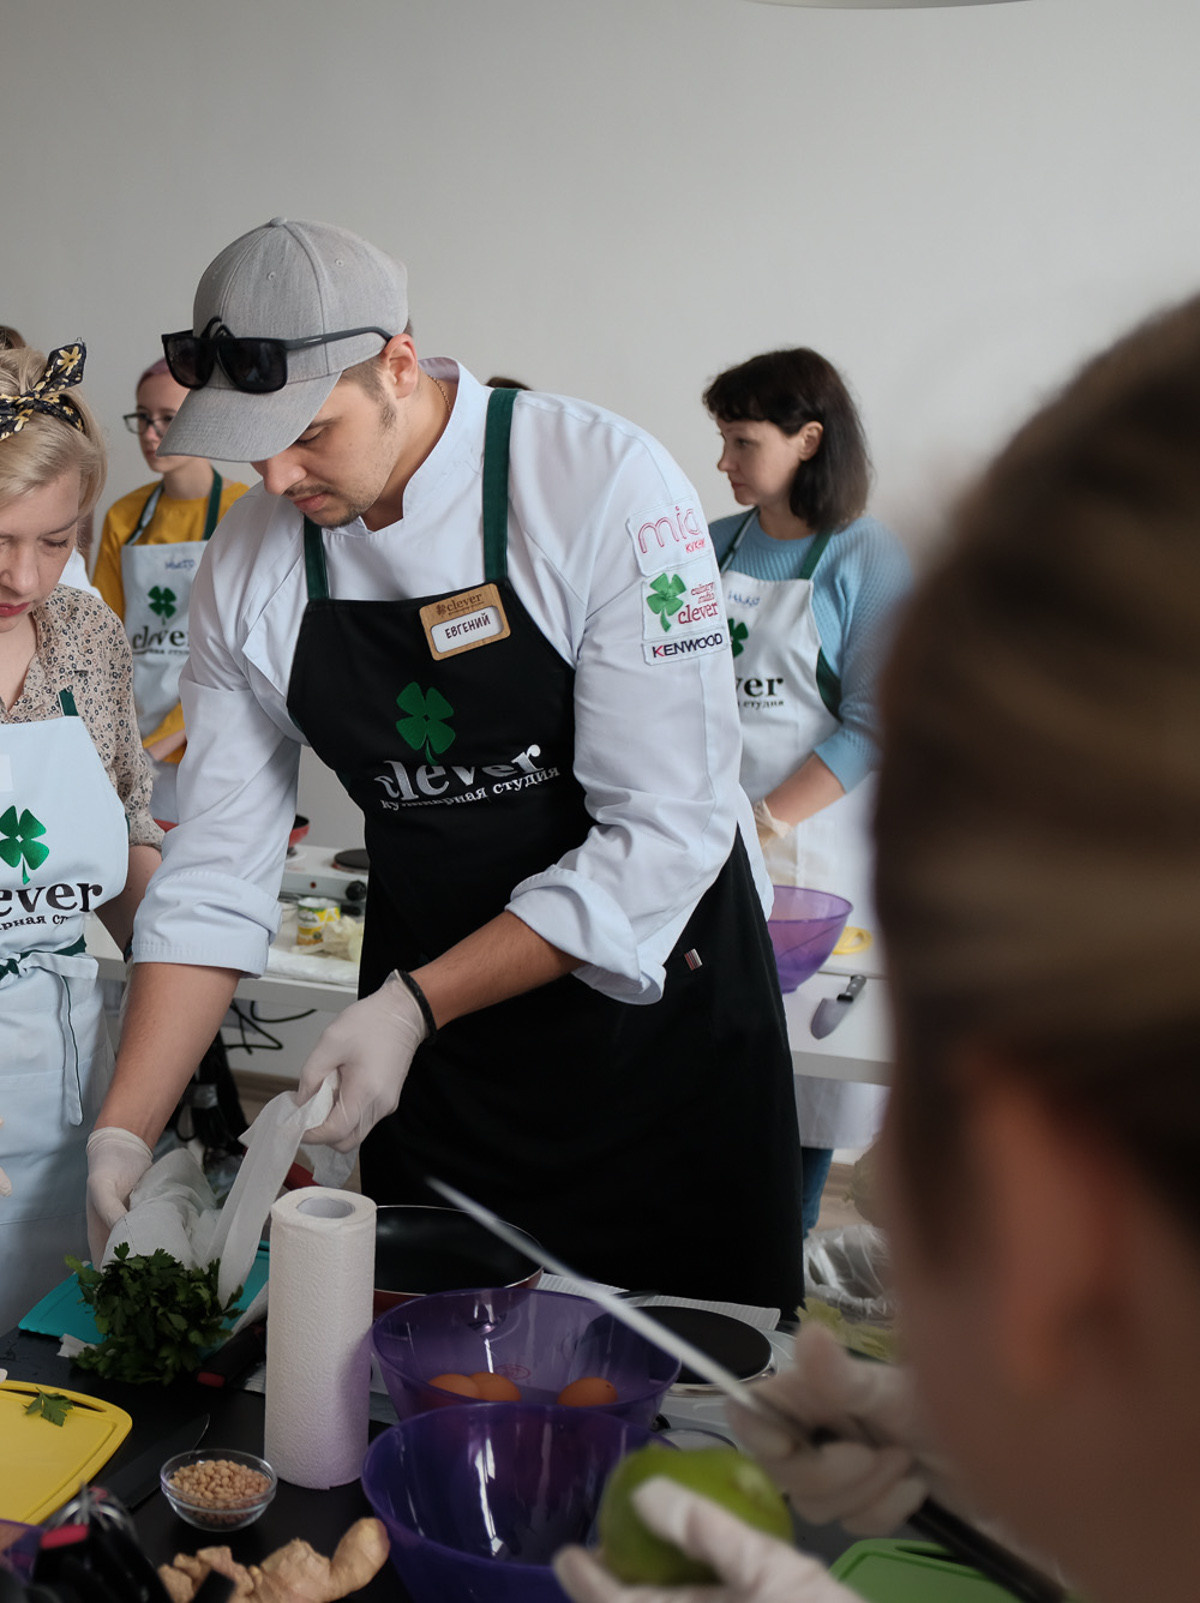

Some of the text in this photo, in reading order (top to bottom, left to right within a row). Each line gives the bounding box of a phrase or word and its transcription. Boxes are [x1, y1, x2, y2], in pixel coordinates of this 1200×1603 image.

[446, 593, 482, 612] clever
[677, 602, 718, 625] clever
[444, 612, 491, 639] ЕВГЕНИЙ
[652, 632, 723, 658] KENWOOD
[492, 767, 561, 795] студия
